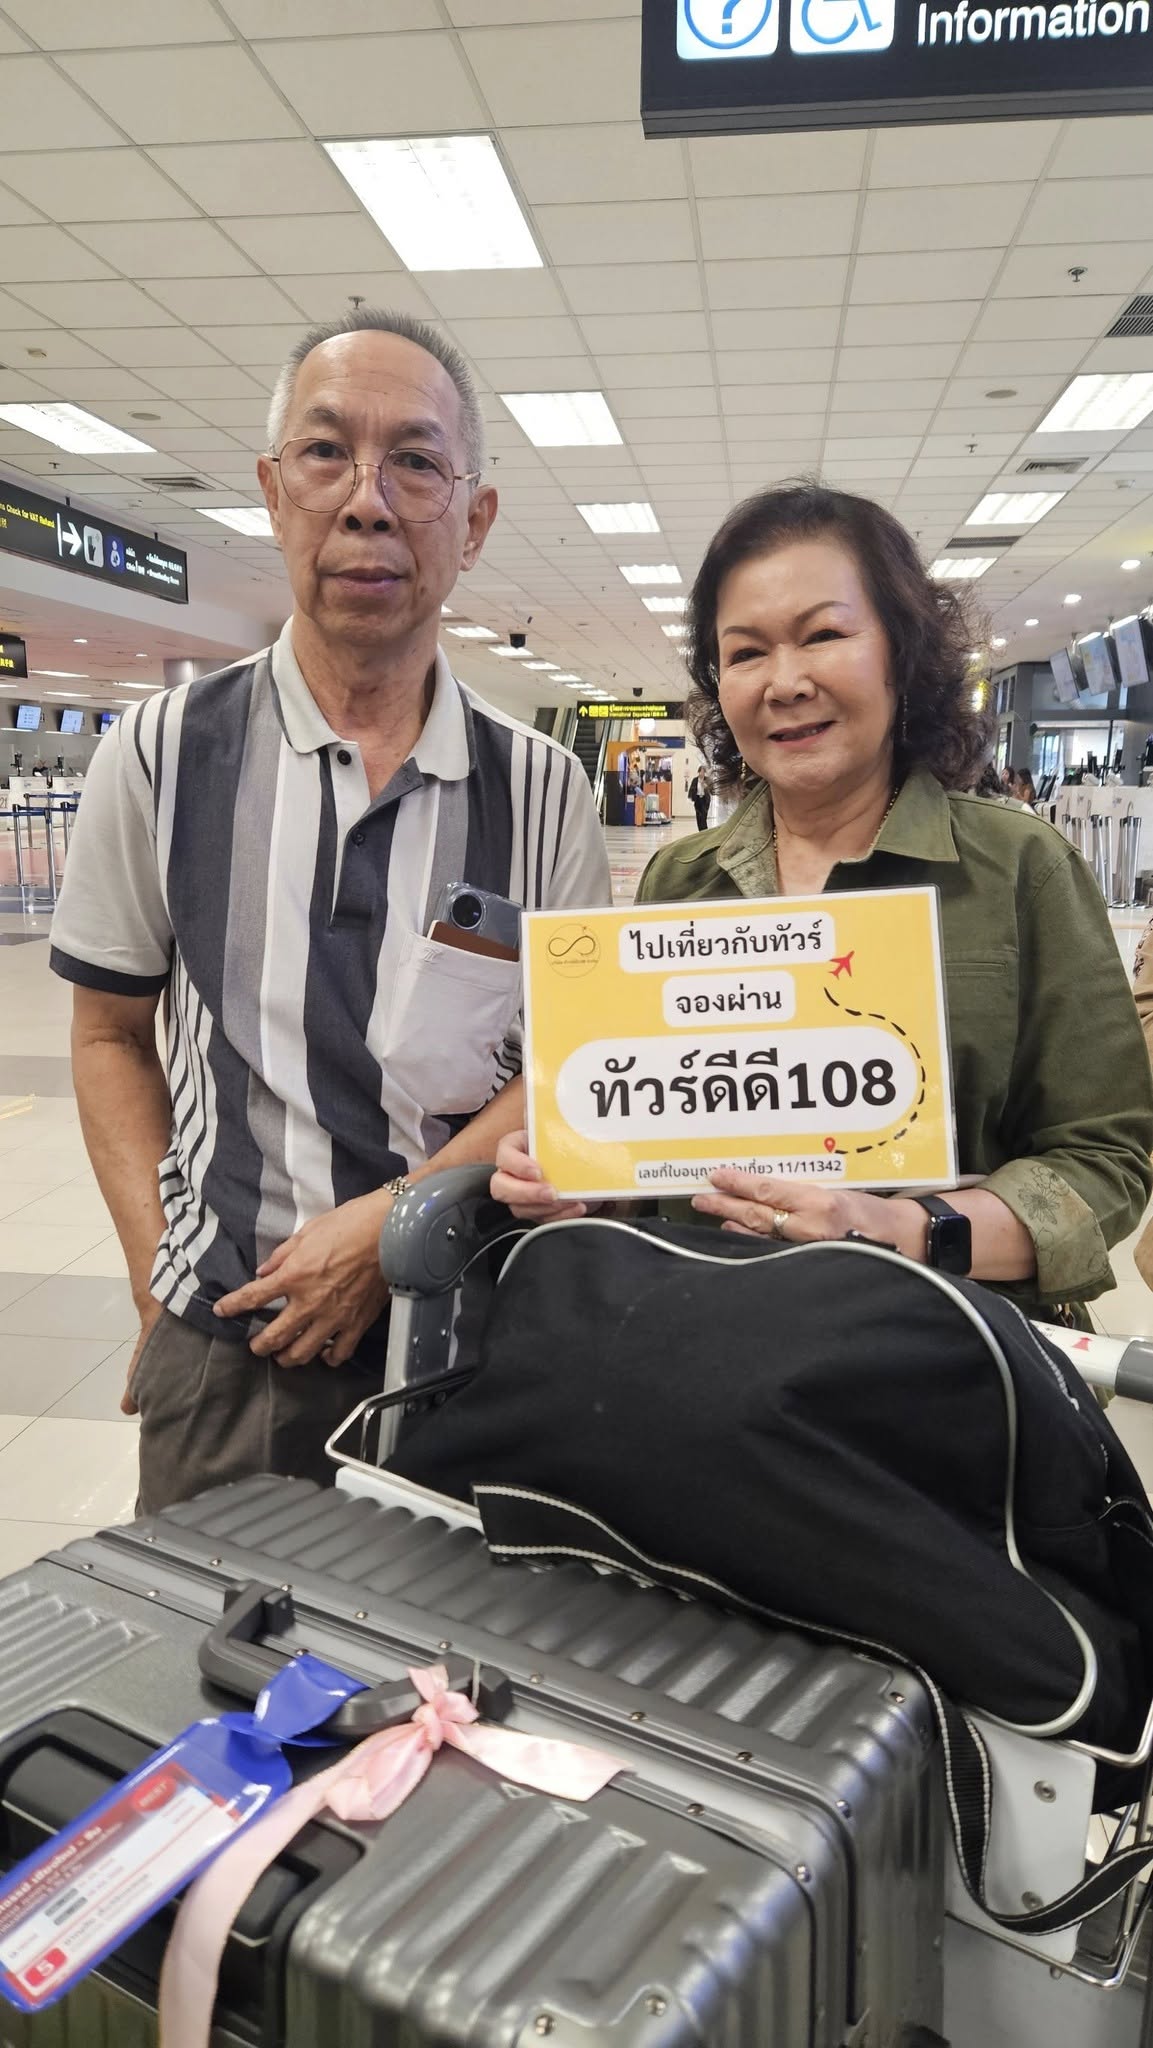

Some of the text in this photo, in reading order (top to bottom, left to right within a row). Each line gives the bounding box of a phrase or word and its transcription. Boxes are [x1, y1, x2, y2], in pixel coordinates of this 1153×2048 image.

[917, 0, 1150, 46] Information
[629, 919, 823, 960] ไปเที่ยวกับทัวร์
[675, 983, 782, 1014] จองผ่าน
[589, 1047, 897, 1118] ทัวร์ดีดี108
[778, 1159, 842, 1174] 11/11342
[36, 1959, 55, 1977] 5
